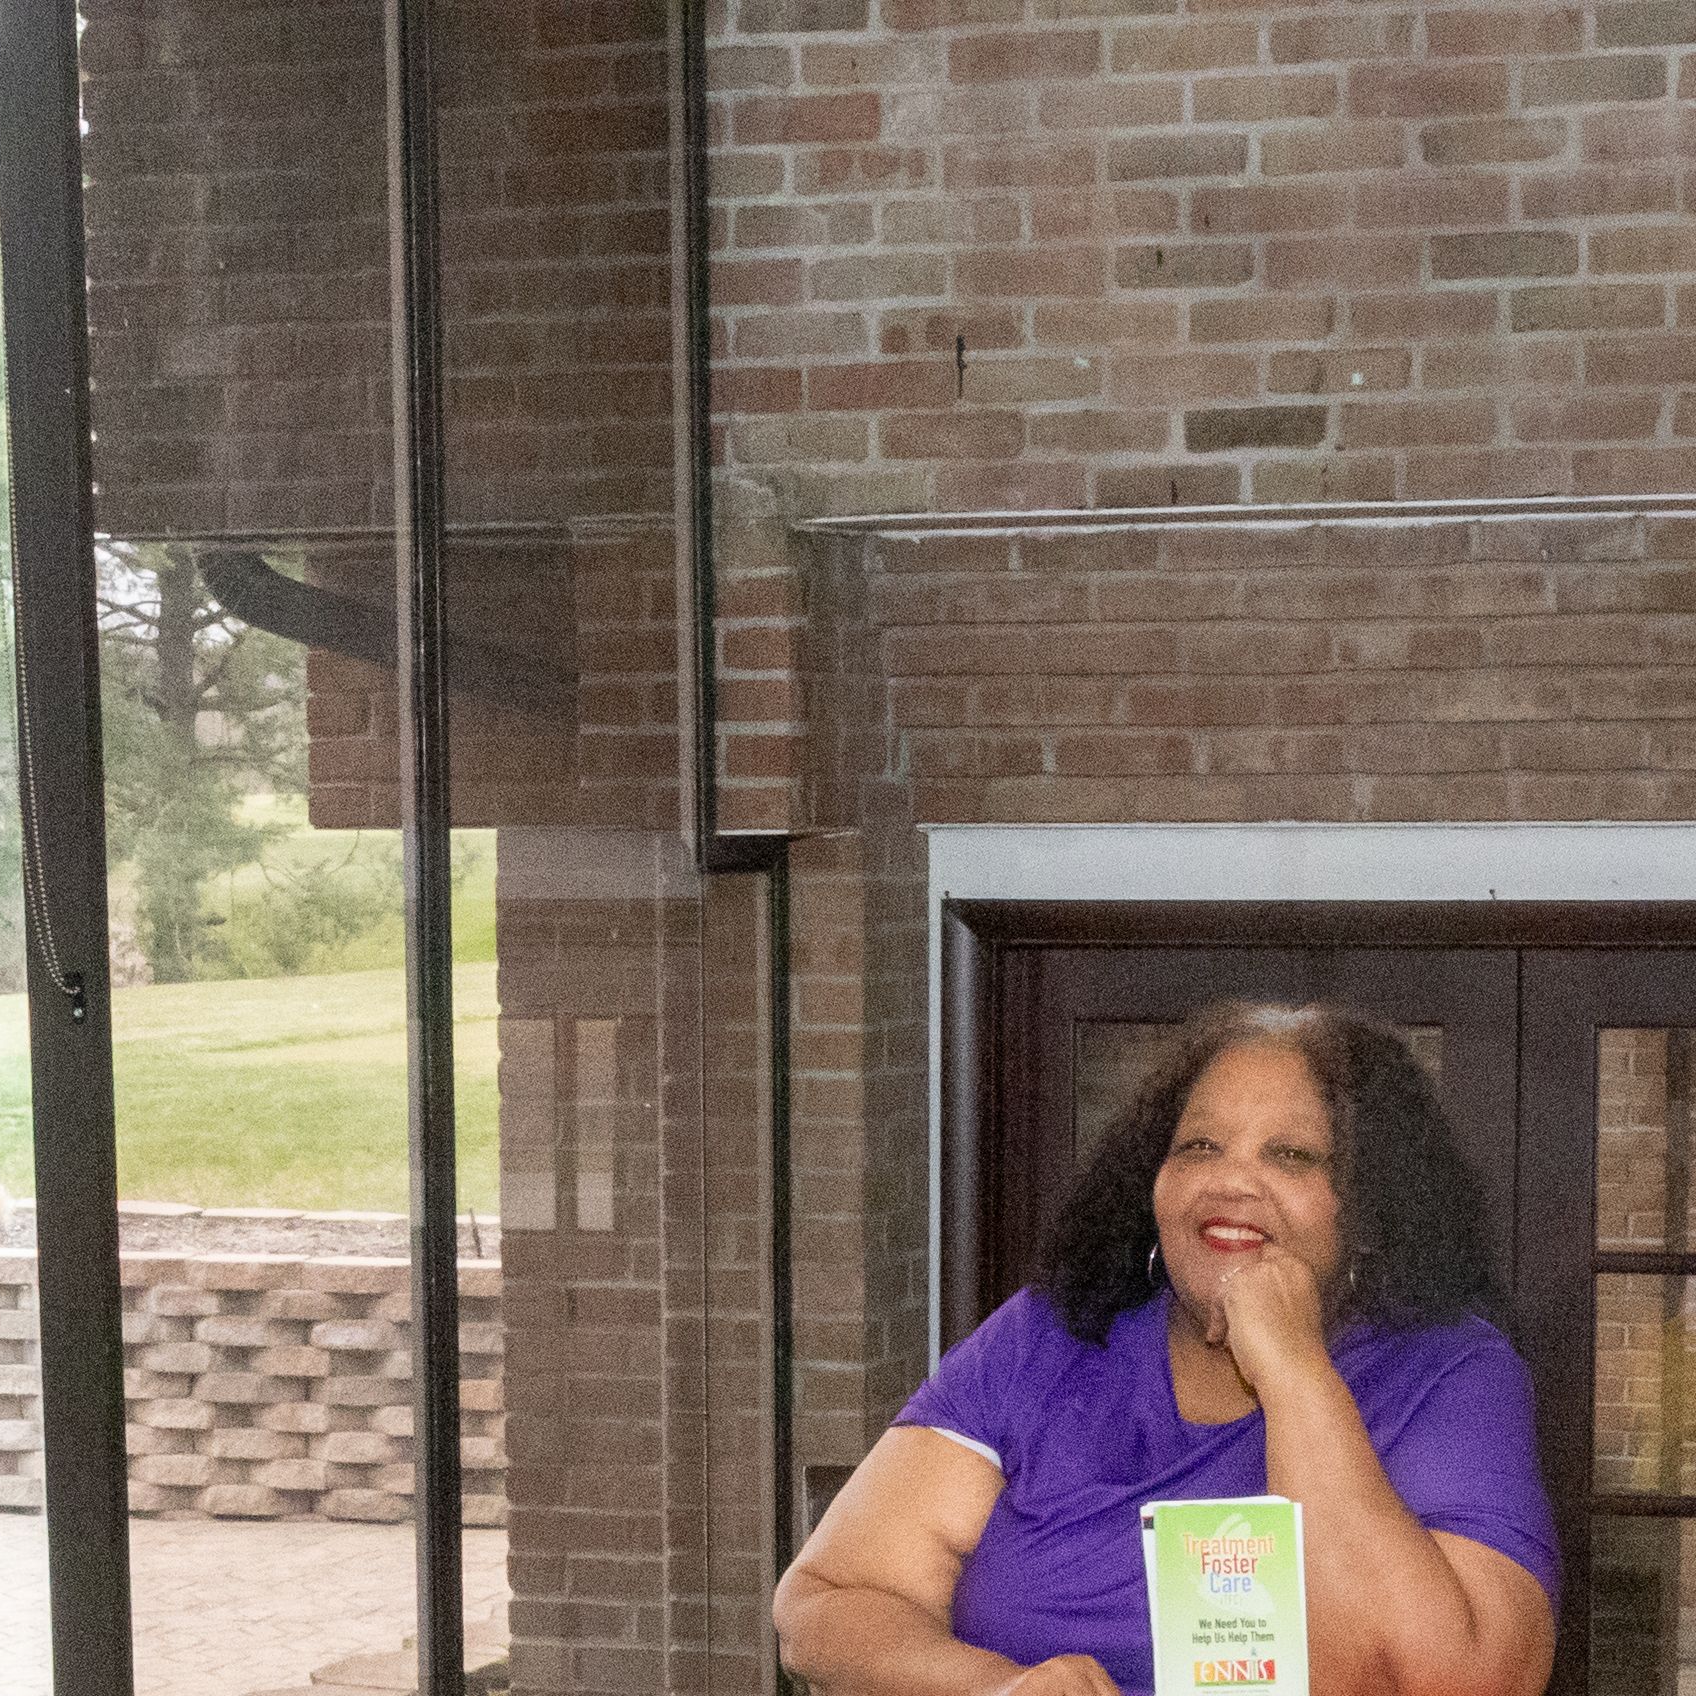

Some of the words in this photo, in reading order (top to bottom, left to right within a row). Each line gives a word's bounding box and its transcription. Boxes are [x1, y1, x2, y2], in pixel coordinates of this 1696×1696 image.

[1183, 1533, 1275, 1556] Treatment
[1201, 1551, 1259, 1575] Foster
[1209, 1572, 1253, 1594] Care
[1198, 1618, 1213, 1630] We
[1215, 1618, 1238, 1630] Need
[1240, 1617, 1256, 1629] You
[1258, 1618, 1267, 1629] to
[1191, 1632, 1213, 1646] Help
[1214, 1632, 1226, 1644] Us
[1228, 1631, 1249, 1645] Help
[1250, 1631, 1275, 1642] Them
[1200, 1658, 1271, 1683] ENNIS
